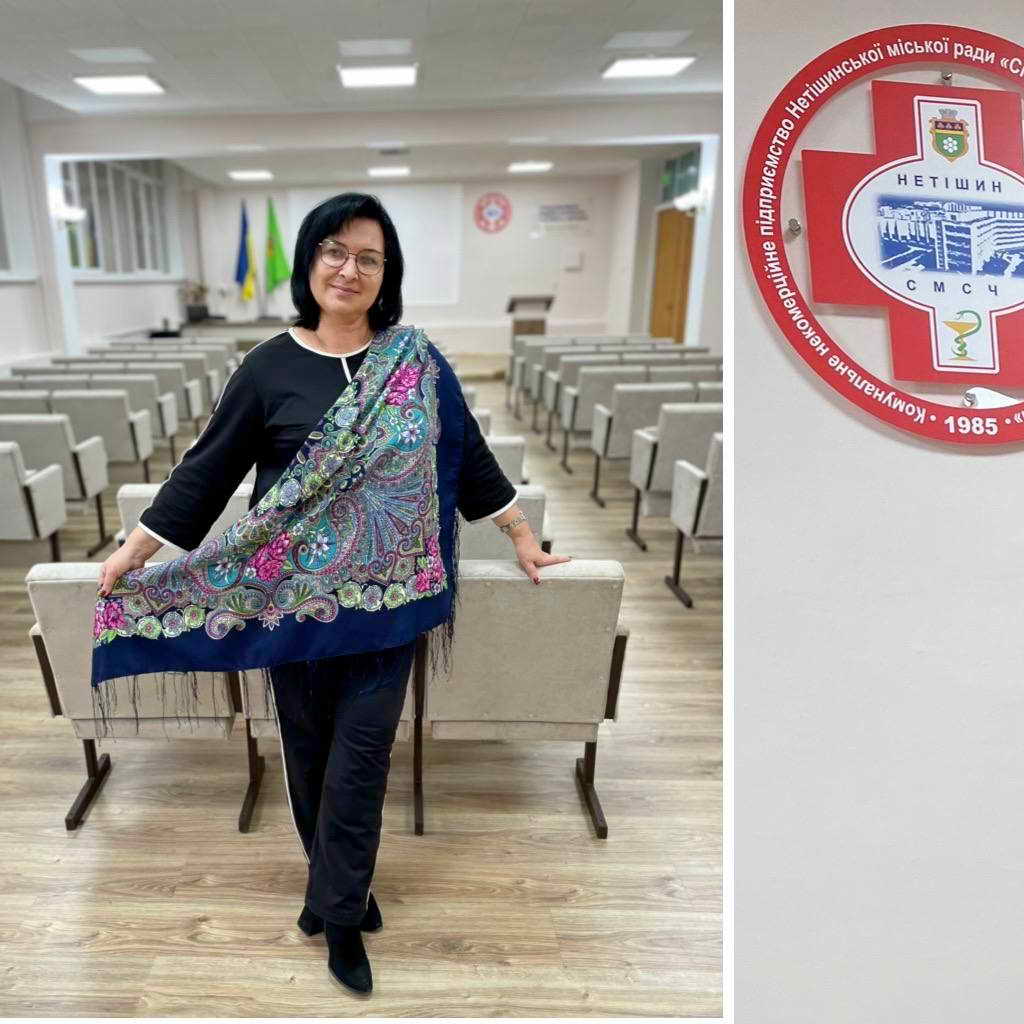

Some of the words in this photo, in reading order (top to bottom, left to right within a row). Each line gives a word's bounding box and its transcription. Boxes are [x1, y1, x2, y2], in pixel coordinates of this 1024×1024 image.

[886, 37, 949, 58] міської
[953, 42, 996, 64] ради
[785, 43, 884, 120] Нетішинської
[755, 119, 795, 236] підприємство
[897, 174, 1002, 192] НЕТІШИН
[762, 241, 830, 357] некомерційне
[828, 354, 927, 424] Комунальне
[944, 415, 999, 436] 1985
